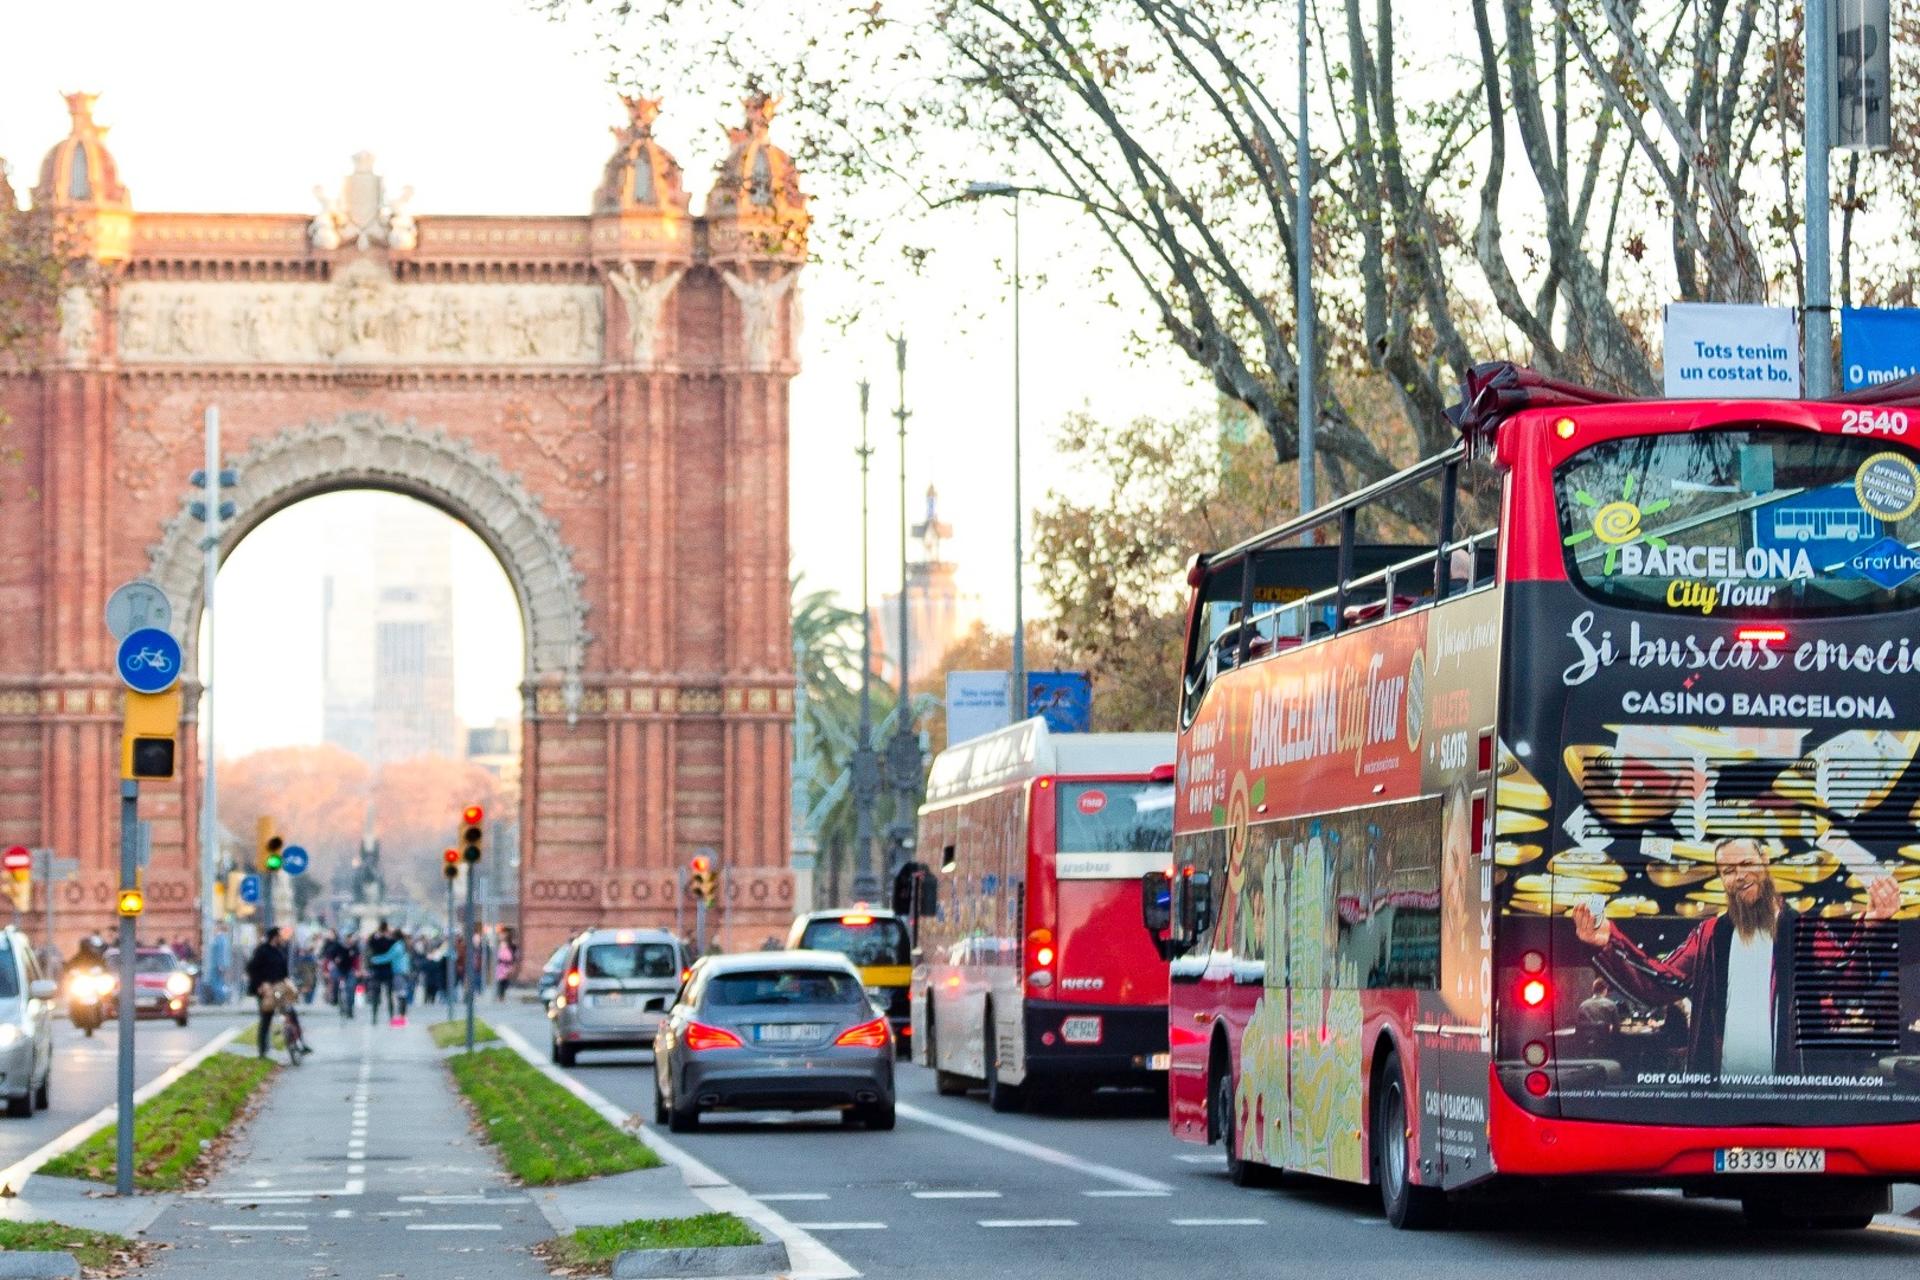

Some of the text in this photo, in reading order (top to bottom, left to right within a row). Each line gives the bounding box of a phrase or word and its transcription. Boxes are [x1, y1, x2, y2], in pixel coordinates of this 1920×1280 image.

[1694, 341, 1788, 360] Tots tenim
[1680, 364, 1792, 382] un costat bo.
[1849, 364, 1864, 384] O
[1840, 409, 1908, 436] 2540
[1863, 474, 1914, 498] BARCELONA
[1873, 464, 1911, 484] OFFICIAL
[1621, 544, 1815, 580] BARCELONA
[1562, 610, 1619, 686] Si
[1629, 620, 1784, 671] buscas
[1250, 664, 1337, 770] BARCELONA
[1621, 690, 1896, 720] CASINO BARCELONA
[1440, 731, 1468, 770] SLOTS
[1061, 977, 1105, 990] IVECO
[1637, 1073, 1666, 1085] PORT
[1668, 1070, 1711, 1085] OLÍMPIC
[1720, 1074, 1883, 1087] WWW.CASINOBARCELONA.COM
[1449, 1094, 1485, 1123] BARCELONA
[1727, 1150, 1821, 1169] 8339 GXX
